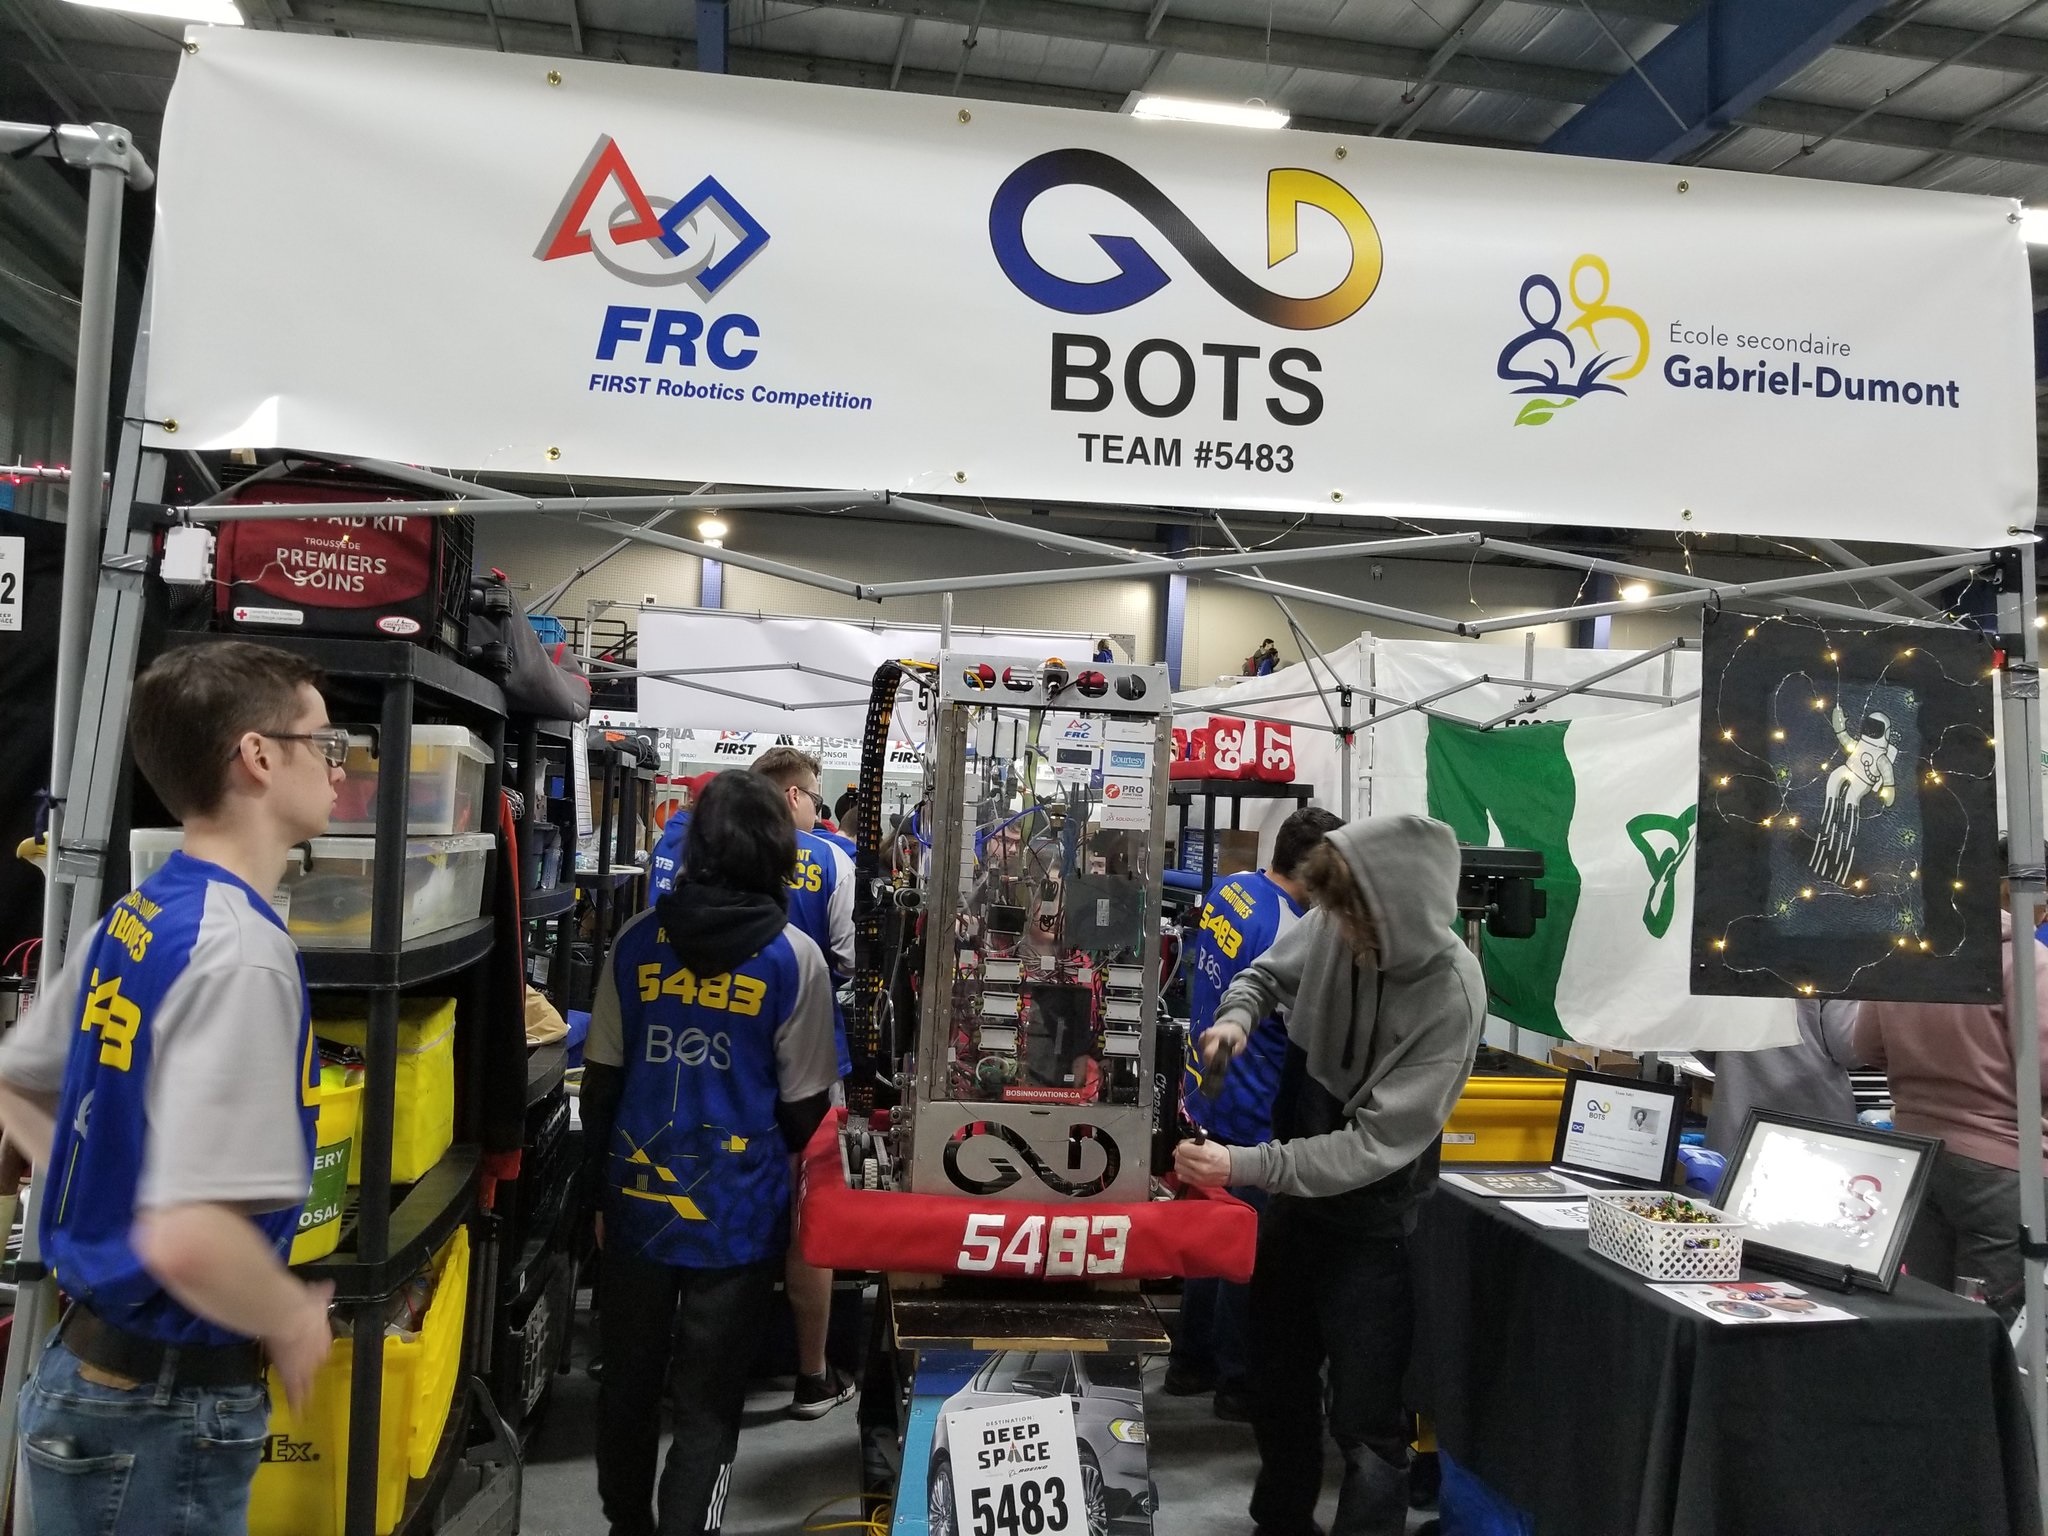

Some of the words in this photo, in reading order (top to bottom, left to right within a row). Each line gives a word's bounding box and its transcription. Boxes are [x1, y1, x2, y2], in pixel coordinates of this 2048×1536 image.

[595, 305, 760, 371] FRC
[1669, 320, 1729, 347] École
[1736, 331, 1851, 358] secondaire
[589, 374, 652, 394] FIRST
[656, 378, 745, 401] Robotics
[751, 385, 873, 410] Competition
[1050, 332, 1325, 427] BOTS
[1663, 353, 1960, 409] Gabriel-Dumont
[1077, 432, 1182, 467] TEAM
[1193, 440, 1295, 474] #5483
[373, 516, 408, 533] KIT
[348, 541, 361, 550] DE
[276, 547, 388, 575] PREMIERS
[294, 569, 365, 592] SOINS
[714, 742, 757, 756] FIRST
[1064, 731, 1091, 739] FRC
[1262, 727, 1291, 771] 37
[1111, 755, 1145, 767] Courtesy
[1122, 785, 1144, 794] PRO
[1199, 902, 1243, 959] 5483
[637, 962, 767, 1017] 5483
[1588, 1112, 1606, 1120] BOTS
[957, 1213, 1132, 1277] 5483
[982, 1423, 1040, 1446] DEEP
[985, 1415, 1036, 1427] DESTINATION:
[978, 1441, 1051, 1470] SPACE
[971, 1476, 1069, 1536] 5483
